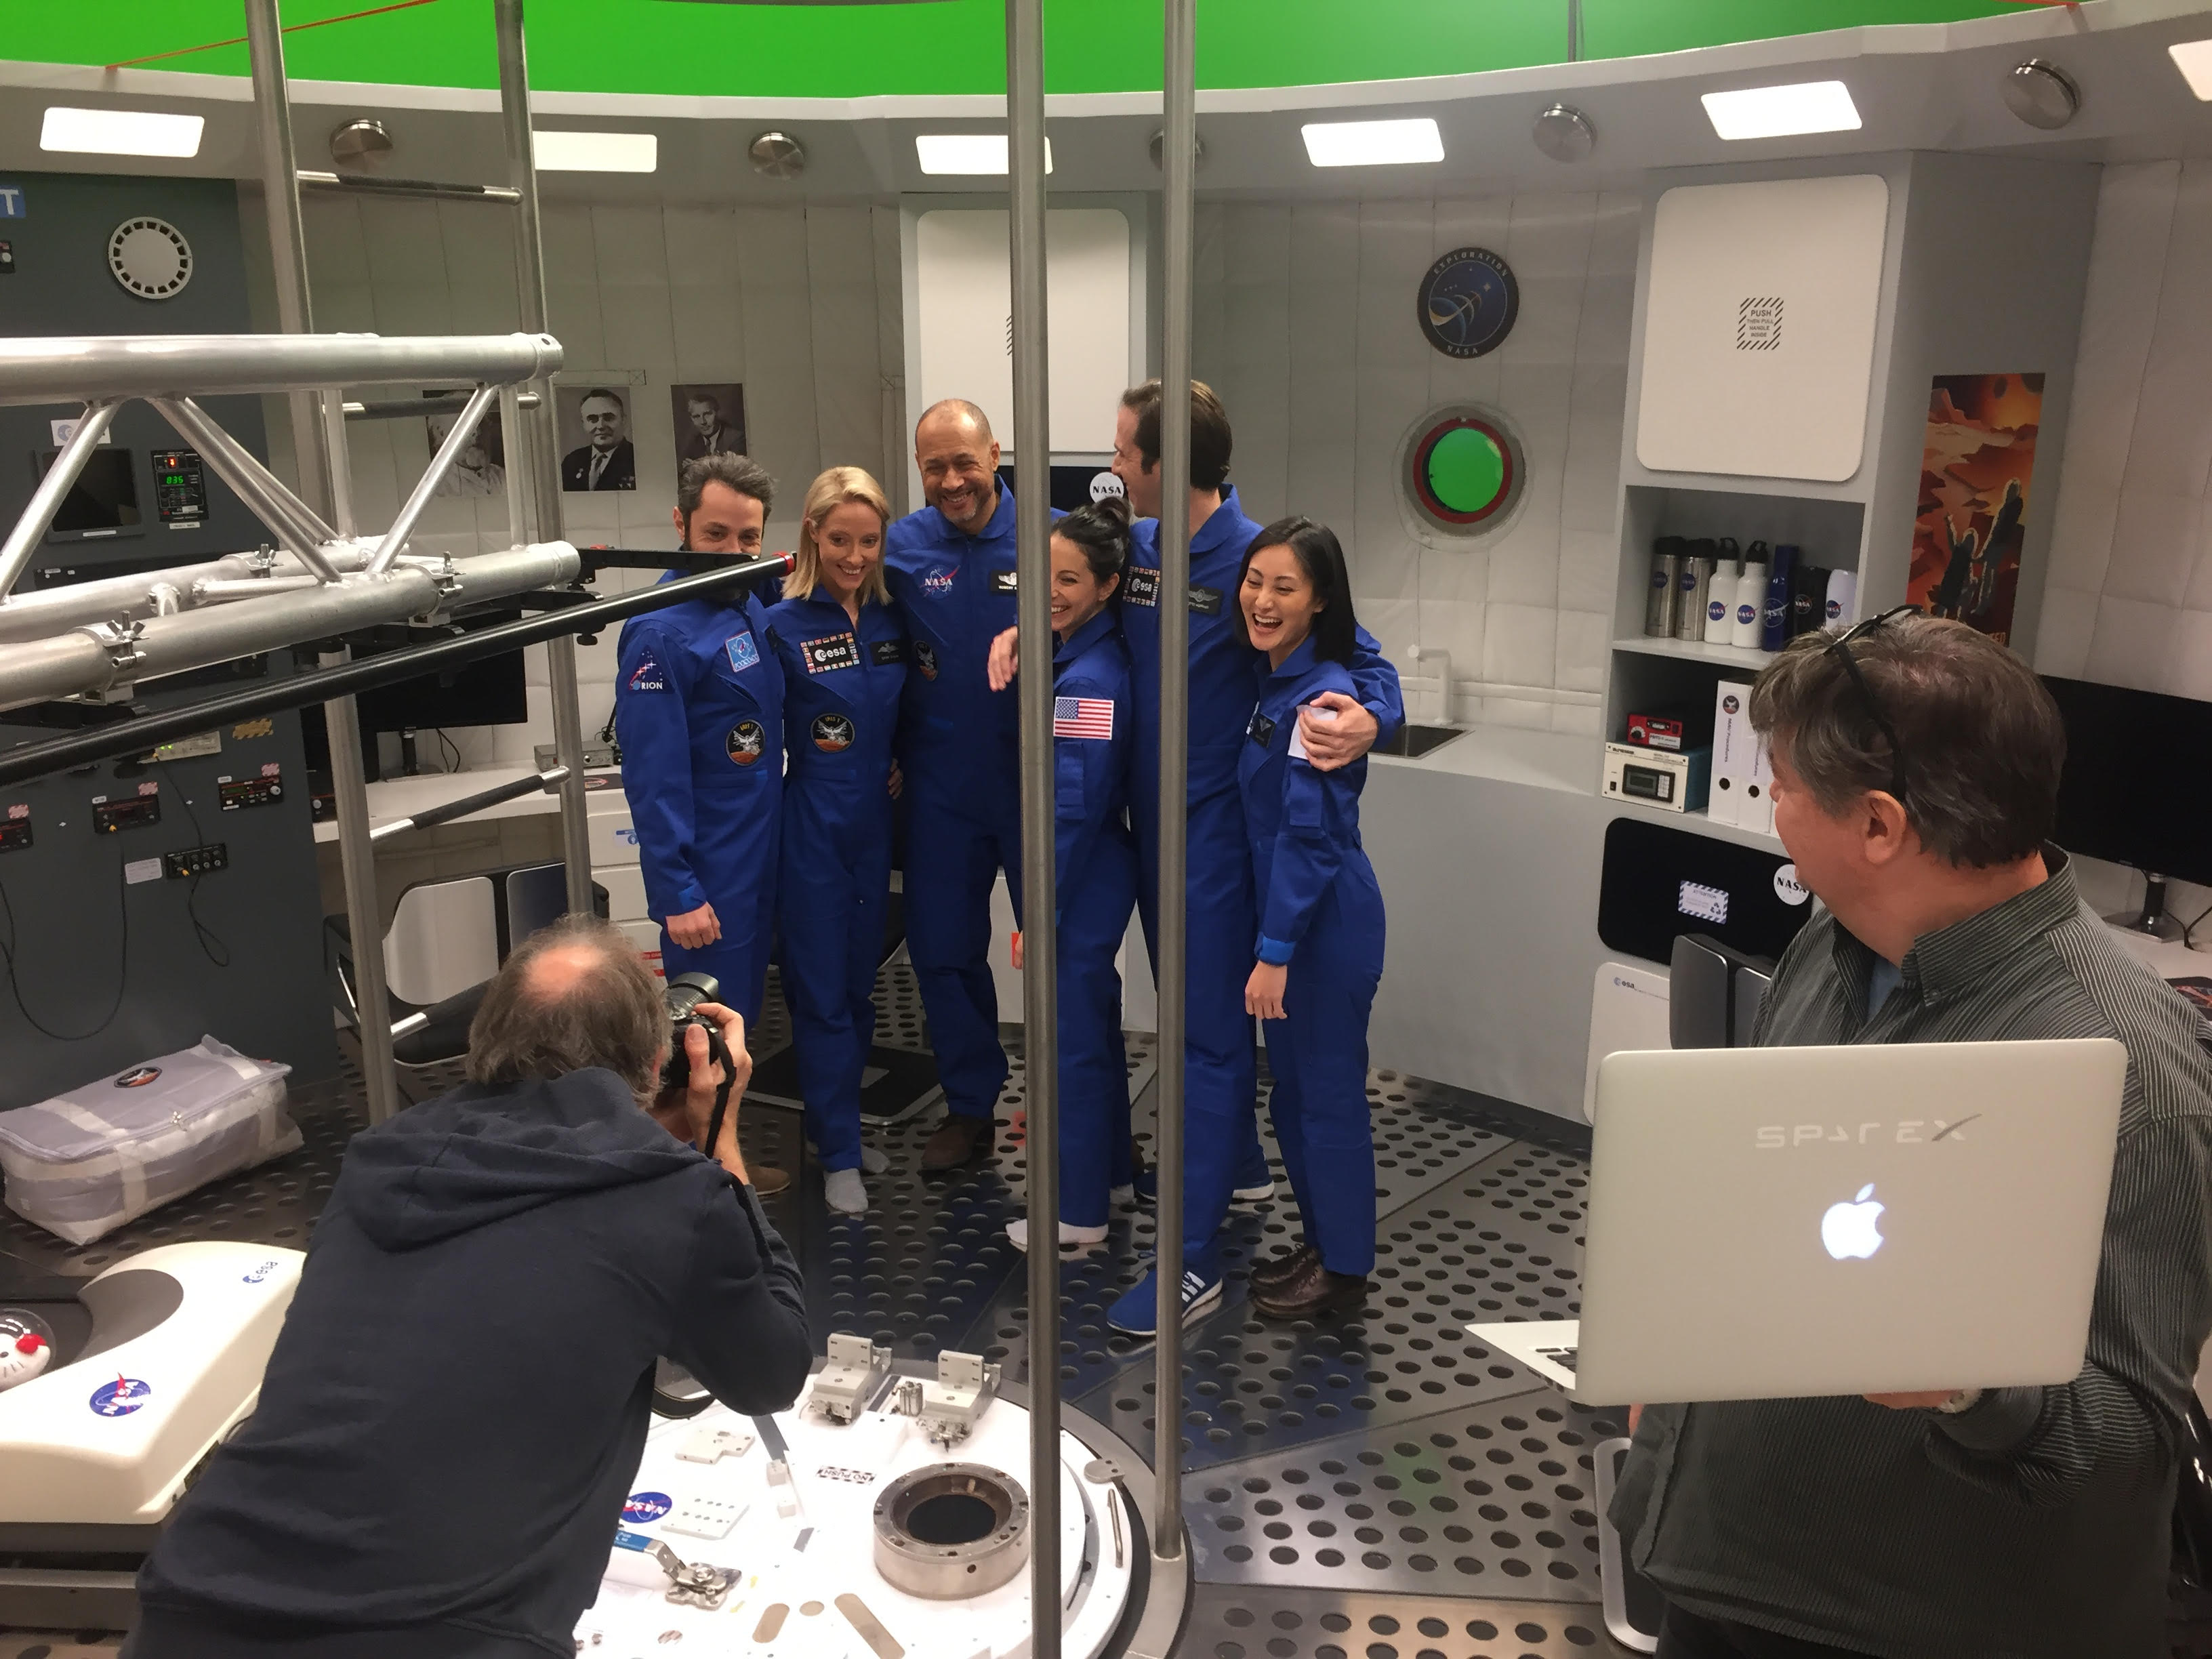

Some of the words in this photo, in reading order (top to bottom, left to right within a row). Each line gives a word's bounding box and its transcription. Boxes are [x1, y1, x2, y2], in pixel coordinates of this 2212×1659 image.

[0, 189, 19, 216] T
[1433, 251, 1509, 276] EXPLORATION
[1448, 345, 1478, 356] NASA
[1092, 486, 1122, 494] NASA
[924, 578, 953, 586] NASA
[255, 1261, 279, 1275] esa
